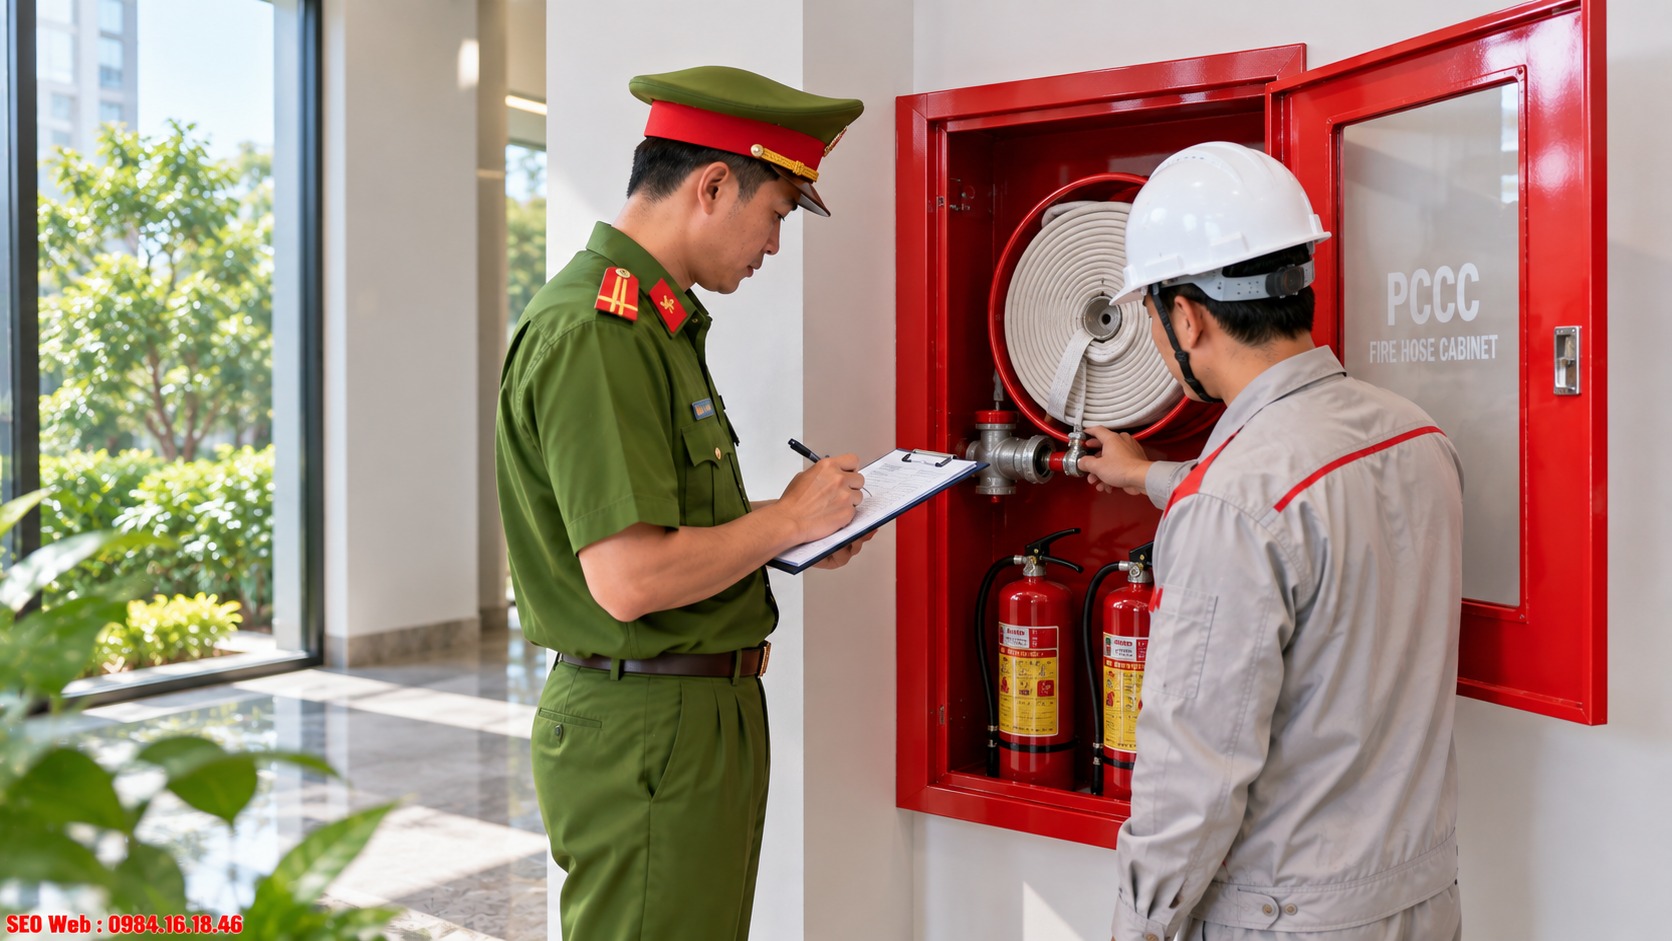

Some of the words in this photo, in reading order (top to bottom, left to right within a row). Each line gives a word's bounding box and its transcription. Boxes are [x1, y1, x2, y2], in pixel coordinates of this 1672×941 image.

[1387, 262, 1480, 326] PCCC
[1369, 340, 1397, 364] FIRE
[1401, 337, 1435, 362] HOSE
[1439, 334, 1498, 361] CABINET
